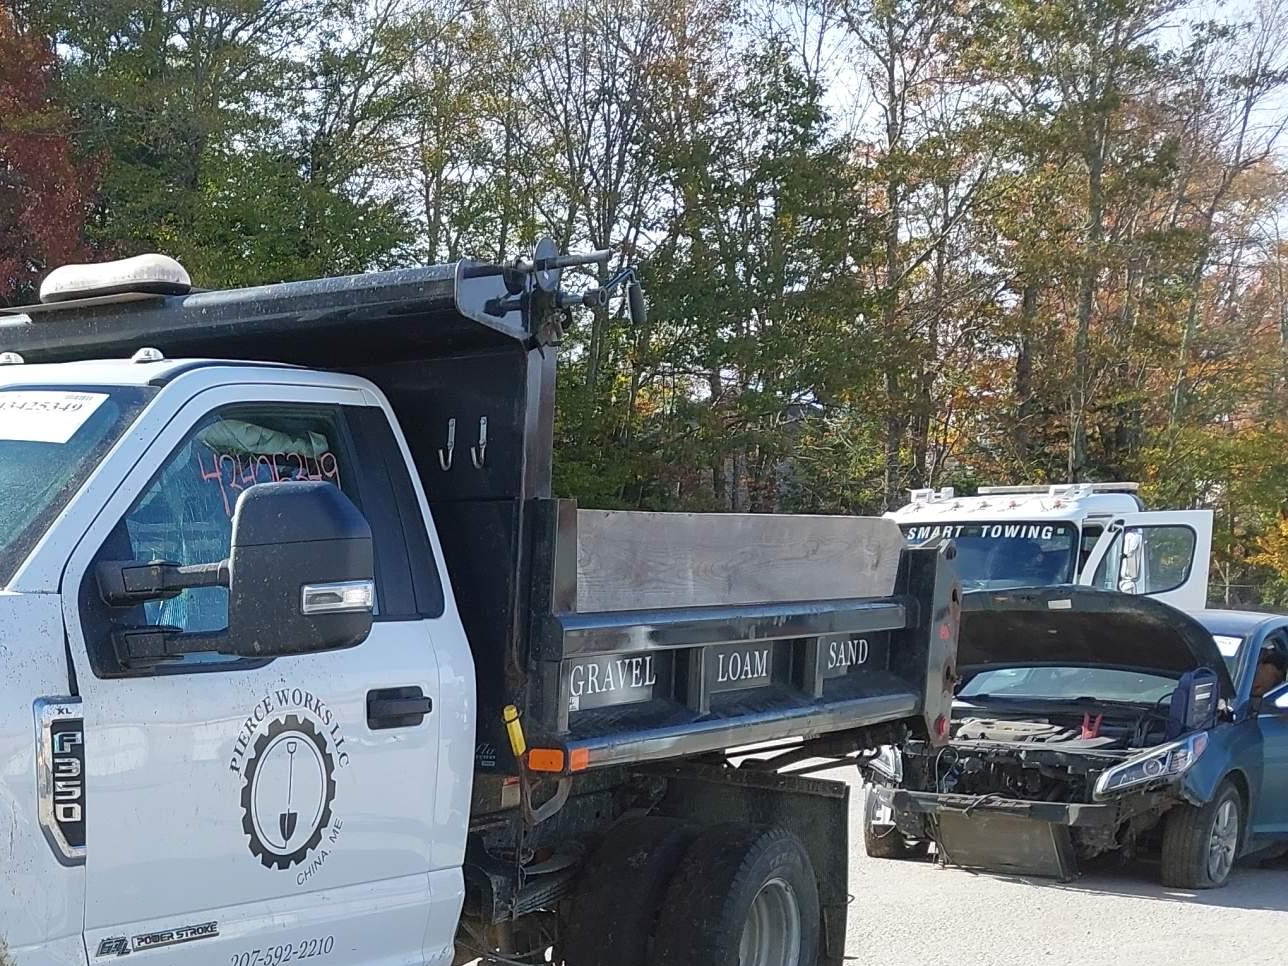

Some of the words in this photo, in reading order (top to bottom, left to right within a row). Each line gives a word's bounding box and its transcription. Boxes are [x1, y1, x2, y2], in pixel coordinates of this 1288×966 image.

[906, 525, 965, 540] SMART
[980, 525, 1054, 540] TOWING
[717, 649, 769, 683] LOAM
[827, 638, 869, 670] SAND
[570, 655, 656, 697] GRAVEL
[229, 696, 275, 774] PIERCE
[275, 688, 333, 726] WORKS
[330, 722, 350, 769] LLC
[53, 731, 83, 823] F350
[329, 818, 344, 844] ME
[136, 932, 175, 947] POWER
[175, 923, 219, 940] STROKE
